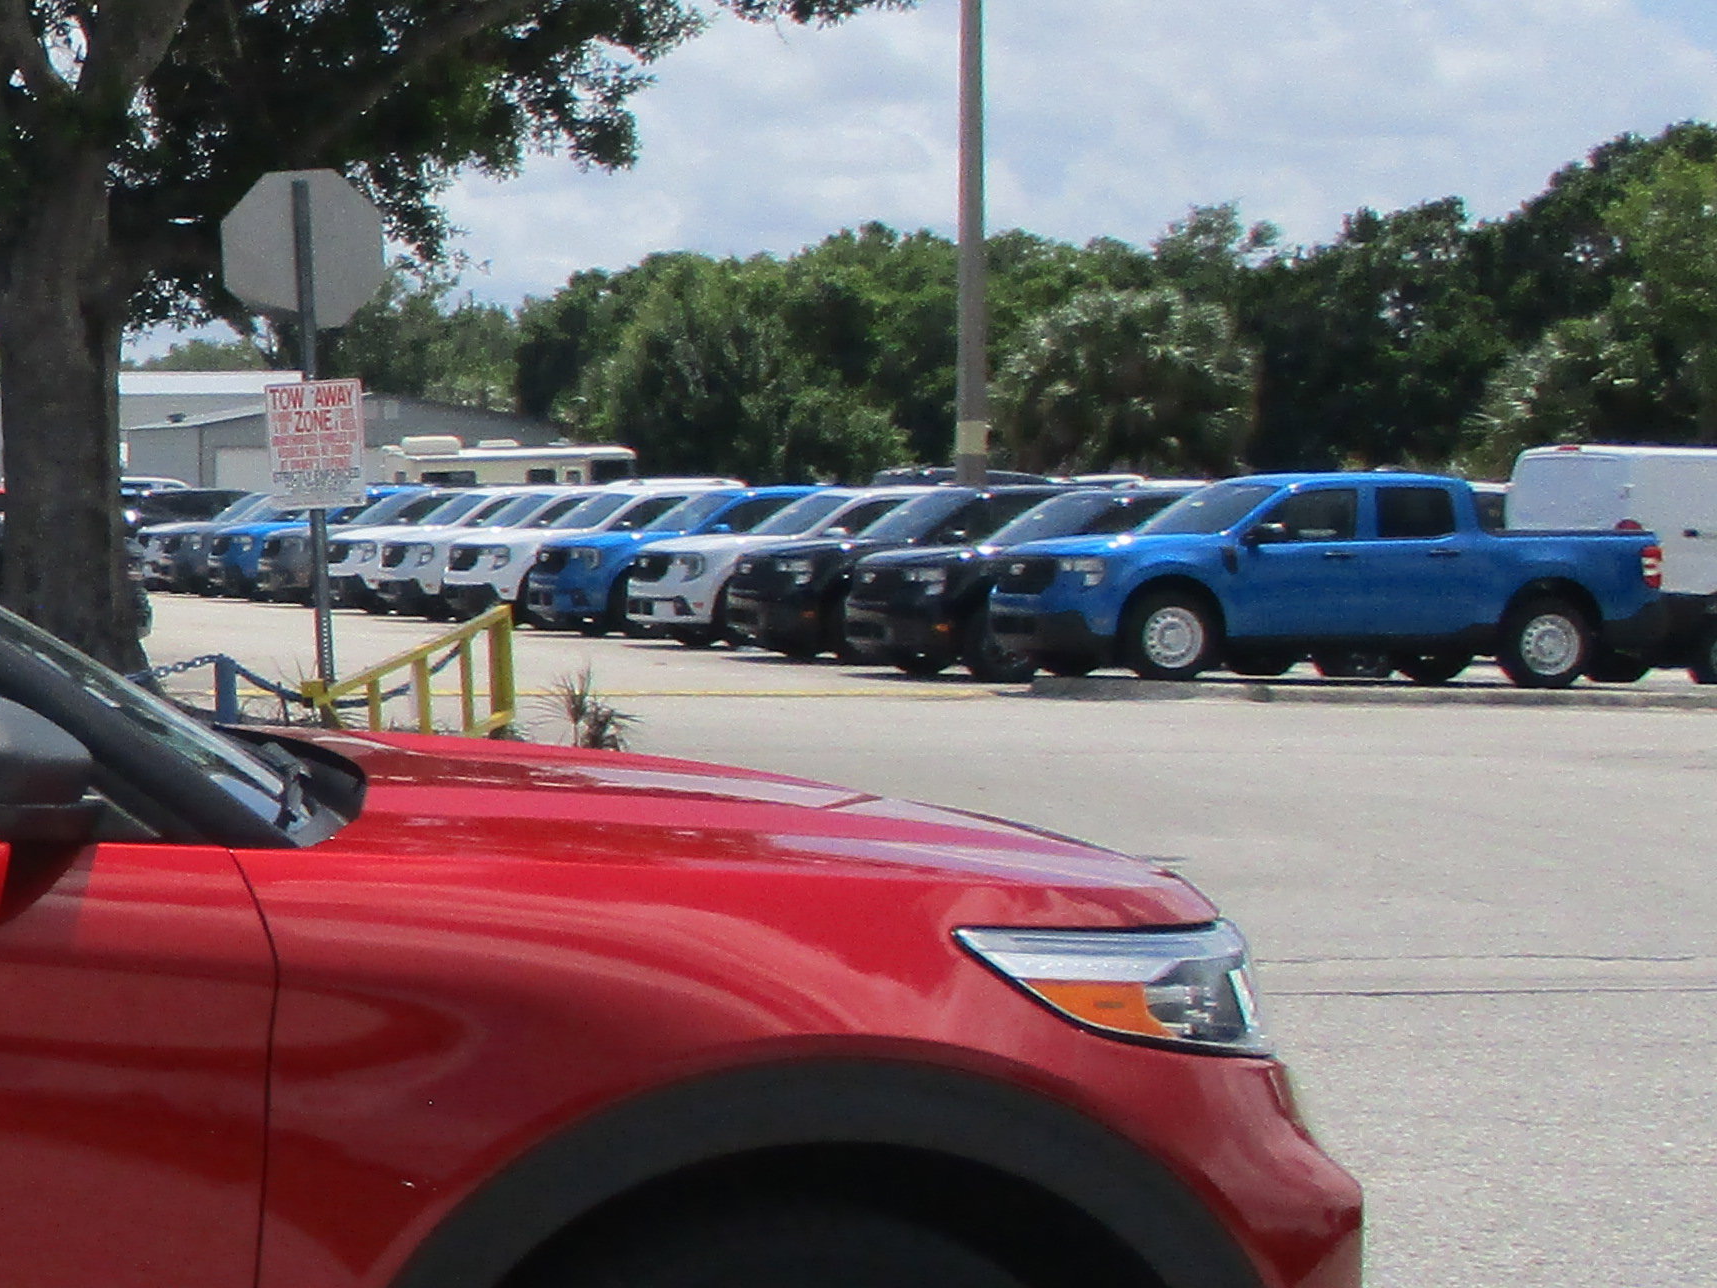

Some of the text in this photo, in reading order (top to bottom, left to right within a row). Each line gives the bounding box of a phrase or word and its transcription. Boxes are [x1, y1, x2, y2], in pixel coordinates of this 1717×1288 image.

[269, 384, 353, 410] TOW AWAY
[294, 409, 332, 432] ZONE
